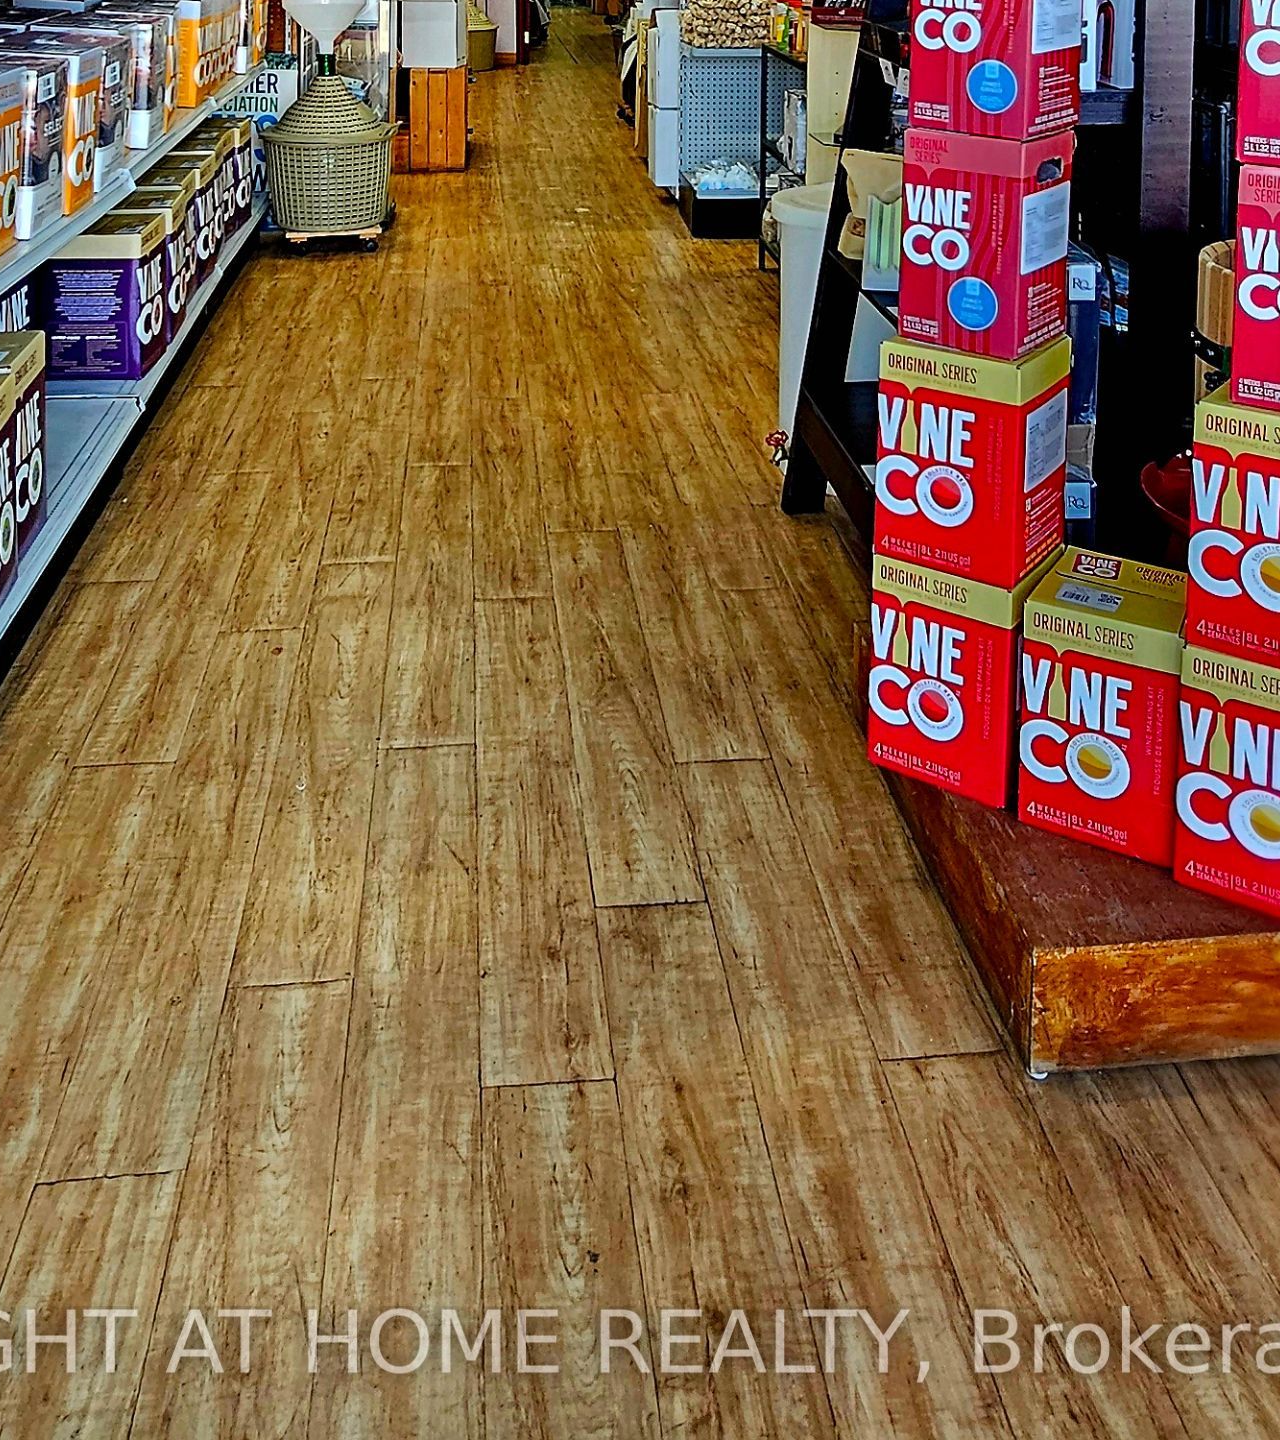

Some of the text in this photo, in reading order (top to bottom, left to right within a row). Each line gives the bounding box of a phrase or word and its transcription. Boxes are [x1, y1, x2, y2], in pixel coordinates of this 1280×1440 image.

[914, 8, 982, 53] CO
[909, 136, 949, 152] ORIGINAL
[914, 150, 941, 165] SERIES
[905, 182, 971, 229] VINE
[902, 223, 970, 271] CO
[136, 254, 163, 303] VINE
[135, 296, 163, 345] CO
[888, 353, 977, 385] ORIGINAL SERIES
[878, 392, 976, 469] VINE
[1205, 413, 1269, 442] ORIGINAL
[874, 453, 975, 528] CO
[880, 564, 968, 604] ORIGINAL SERIES
[1076, 564, 1117, 578] CO
[1079, 555, 1118, 571] VINE
[871, 602, 966, 686] VINE
[1032, 611, 1135, 651] ORIGINAL SERIES
[1196, 618, 1206, 636] 4
[1022, 652, 1132, 739] VINE
[1192, 657, 1257, 690] ORIGINAL
[868, 664, 965, 742] CO
[1019, 718, 1131, 800] CO
